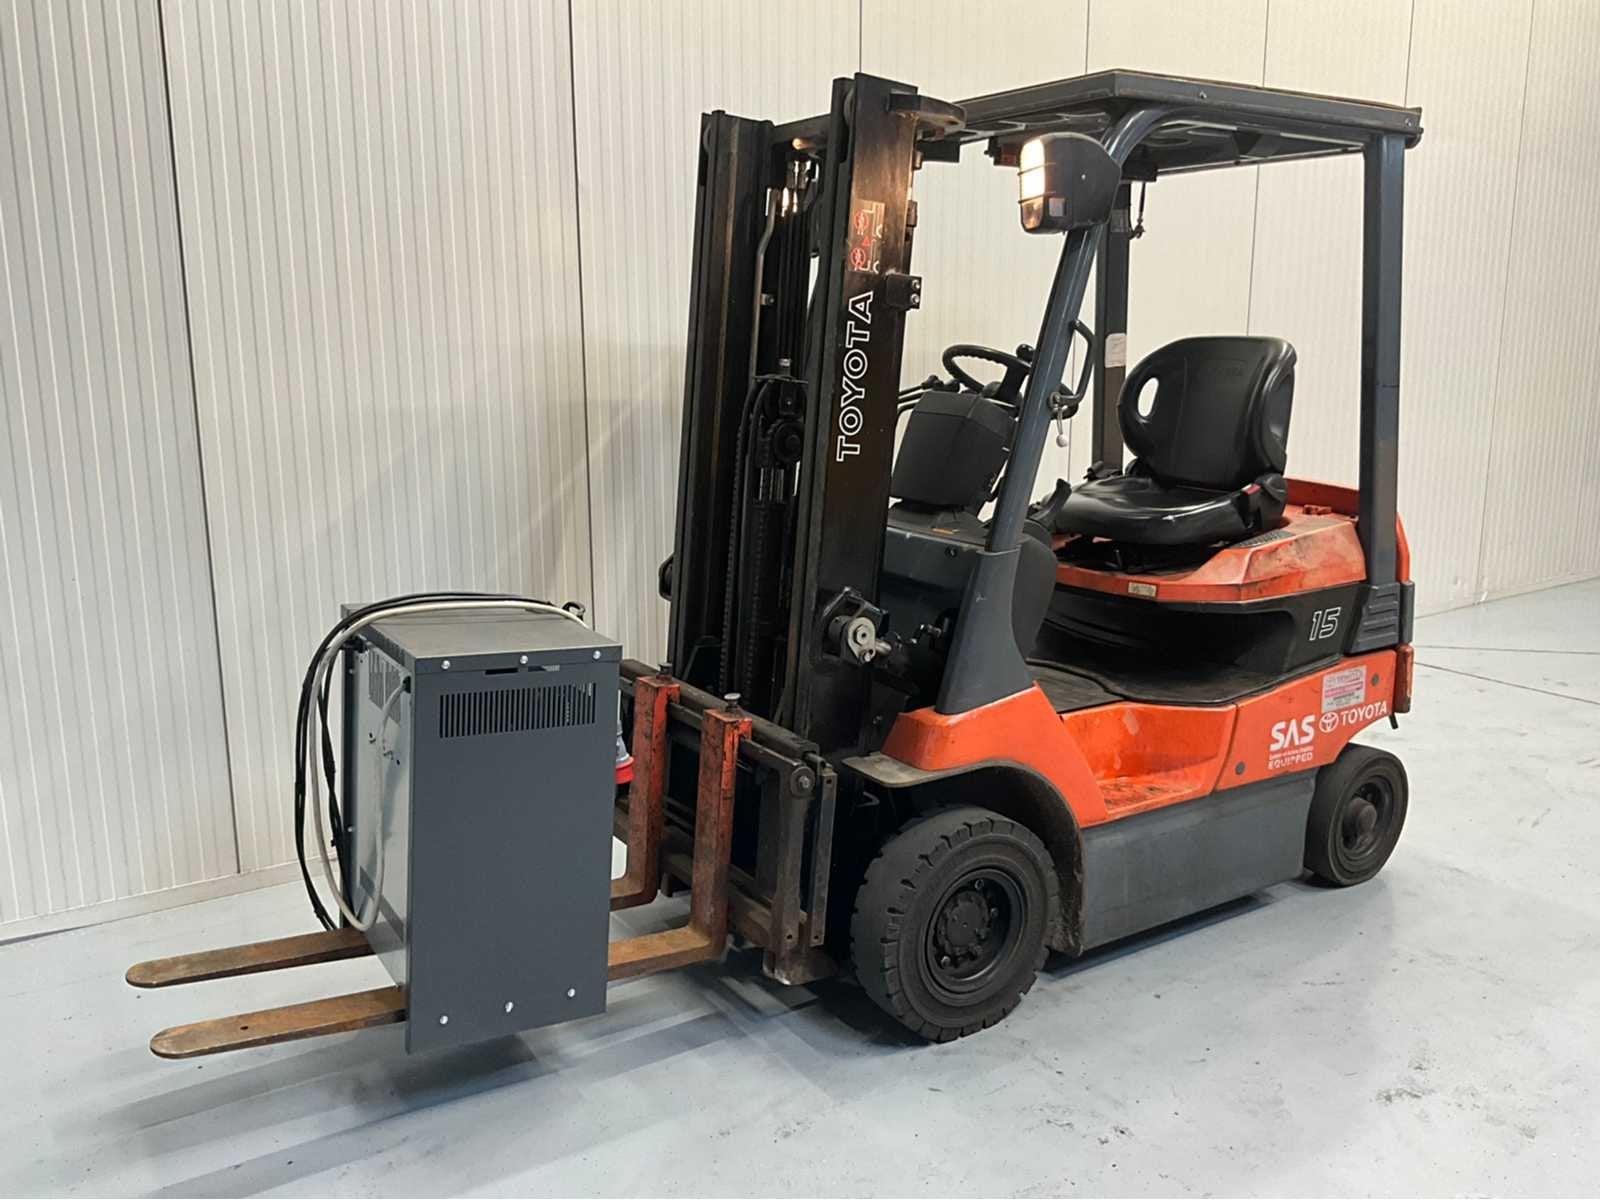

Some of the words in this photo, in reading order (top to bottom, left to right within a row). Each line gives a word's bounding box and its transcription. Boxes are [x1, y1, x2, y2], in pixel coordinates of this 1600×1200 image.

[836, 291, 874, 462] TOYOTA
[1309, 606, 1341, 641] 15
[1340, 701, 1388, 726] TOYOTA
[1269, 714, 1316, 751] SAS
